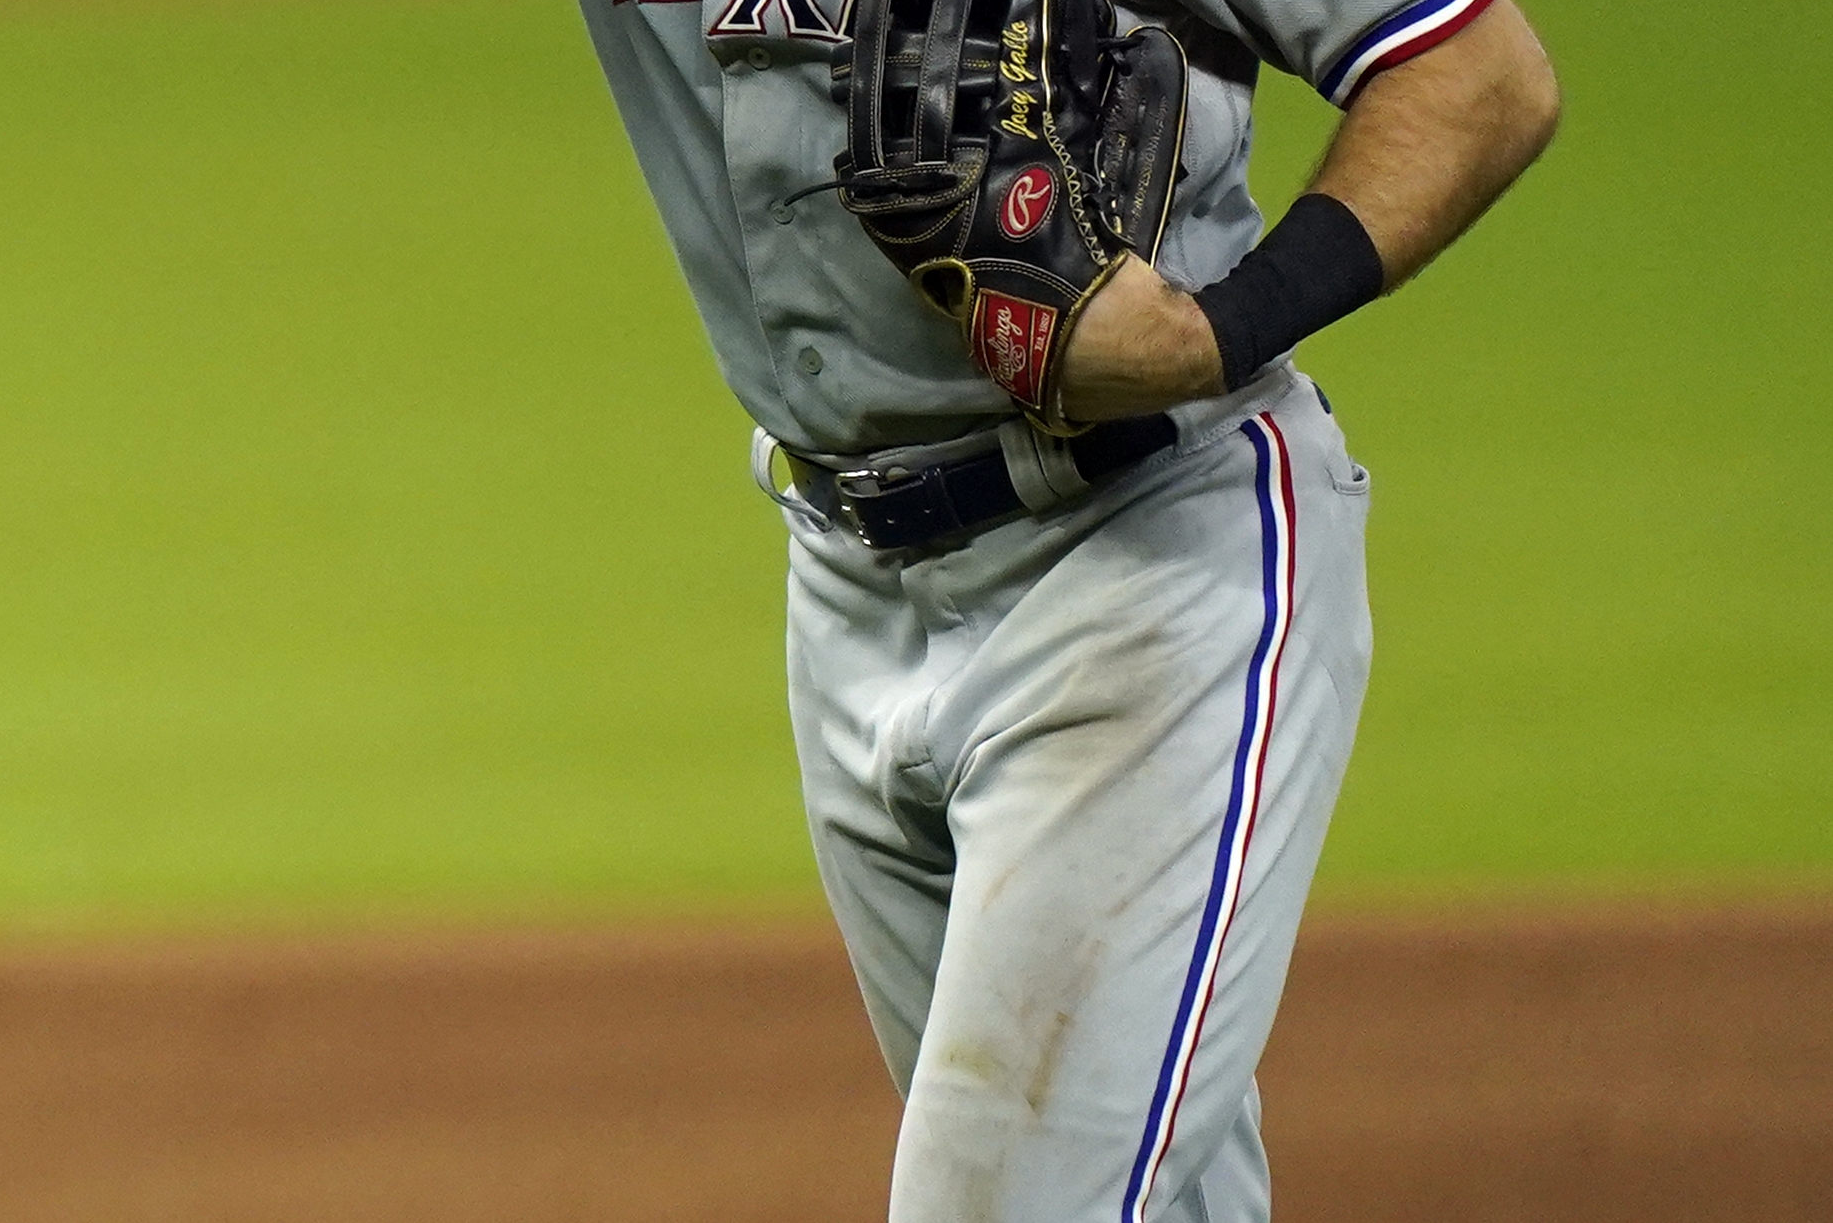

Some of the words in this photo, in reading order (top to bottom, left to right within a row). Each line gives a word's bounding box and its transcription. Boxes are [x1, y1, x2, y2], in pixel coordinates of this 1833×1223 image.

[999, 19, 1038, 83] Gallo
[1000, 89, 1039, 141] Joey
[1007, 174, 1051, 233] R
[986, 305, 1024, 393] Rawlings
